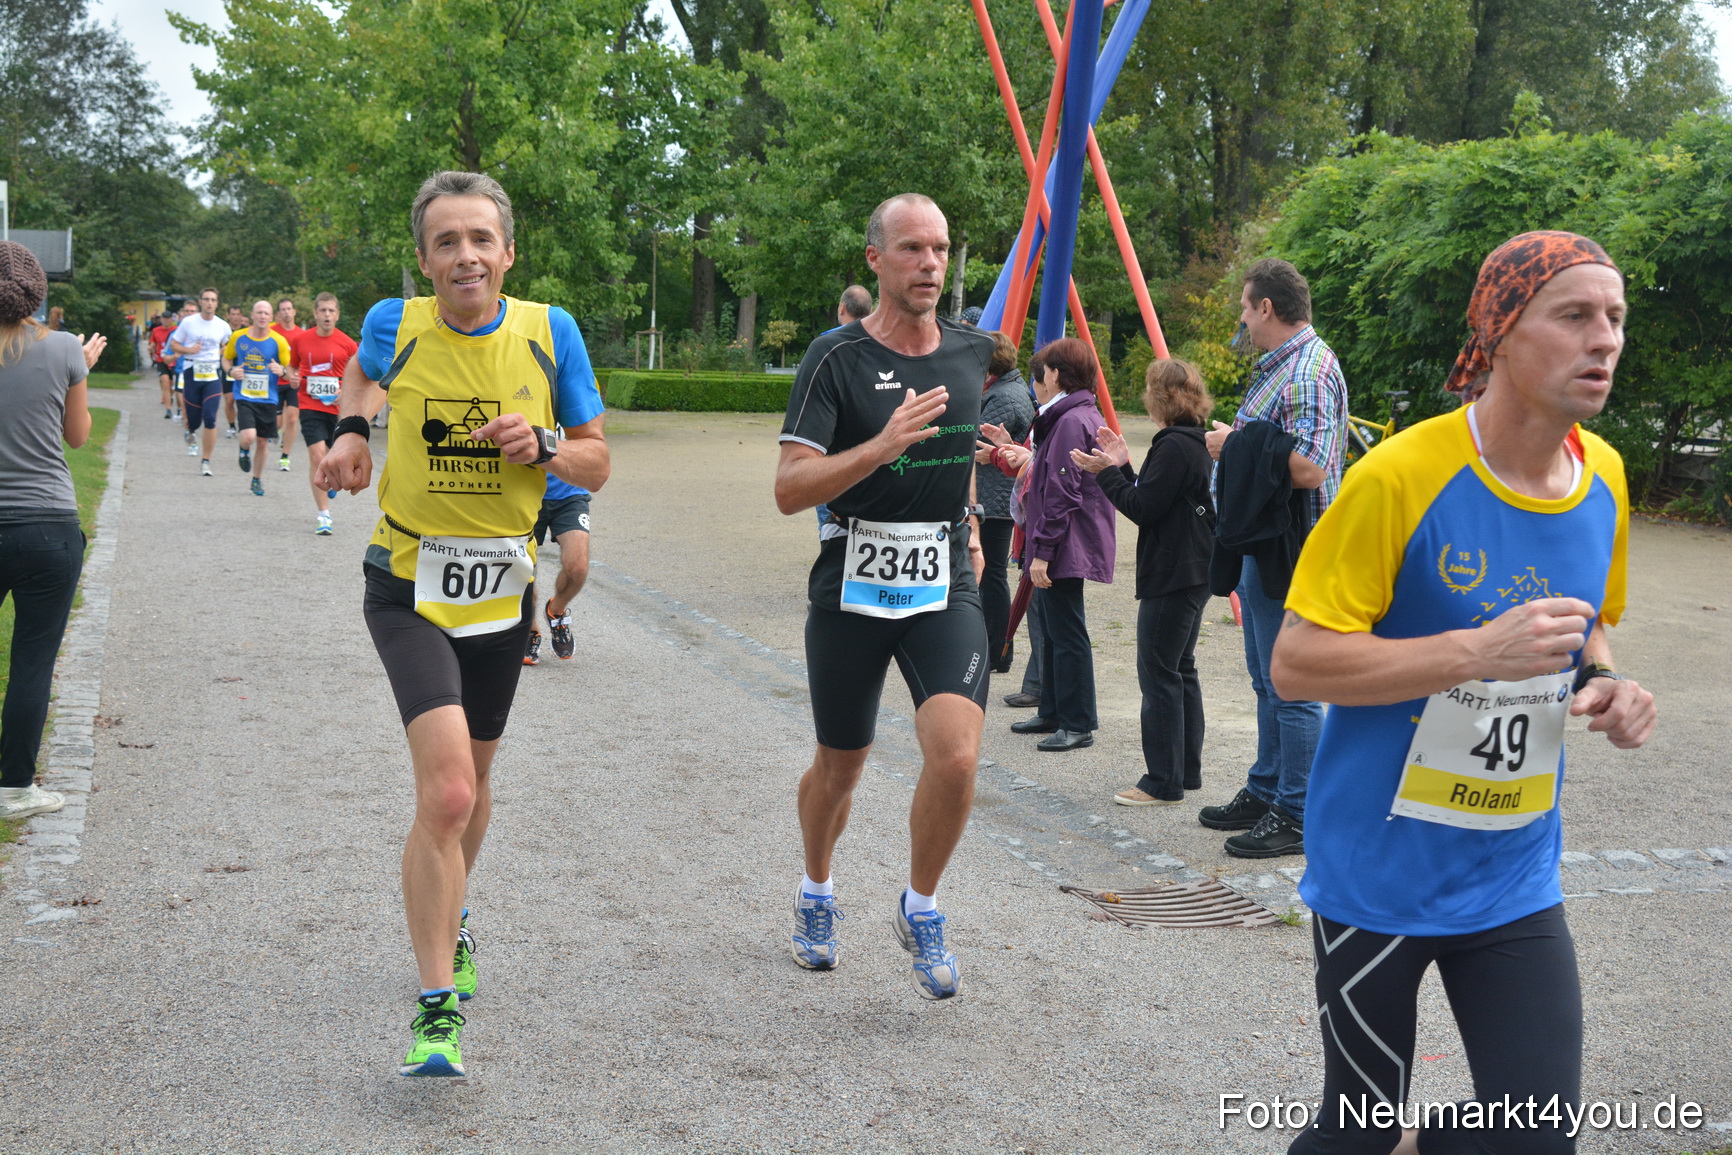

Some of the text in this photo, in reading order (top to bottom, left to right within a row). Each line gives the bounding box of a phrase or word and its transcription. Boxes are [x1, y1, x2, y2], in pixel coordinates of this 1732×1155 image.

[247, 380, 264, 390] 267
[310, 384, 336, 394] 2340
[875, 382, 901, 390] erima
[428, 458, 500, 474] HIRSCH
[428, 480, 501, 489] APOTHEKE
[852, 526, 933, 542] PARTL Neumarkt
[422, 540, 517, 558] PARTL Neumarkt
[1458, 552, 1471, 561] 15
[856, 542, 939, 582] 2343
[1448, 563, 1477, 576] Jahre
[442, 561, 513, 600] 607
[878, 590, 914, 605] Peter
[1438, 687, 1554, 710] ARTL Neumarkt
[1469, 713, 1529, 772] 49
[1450, 783, 1523, 809] Roland
